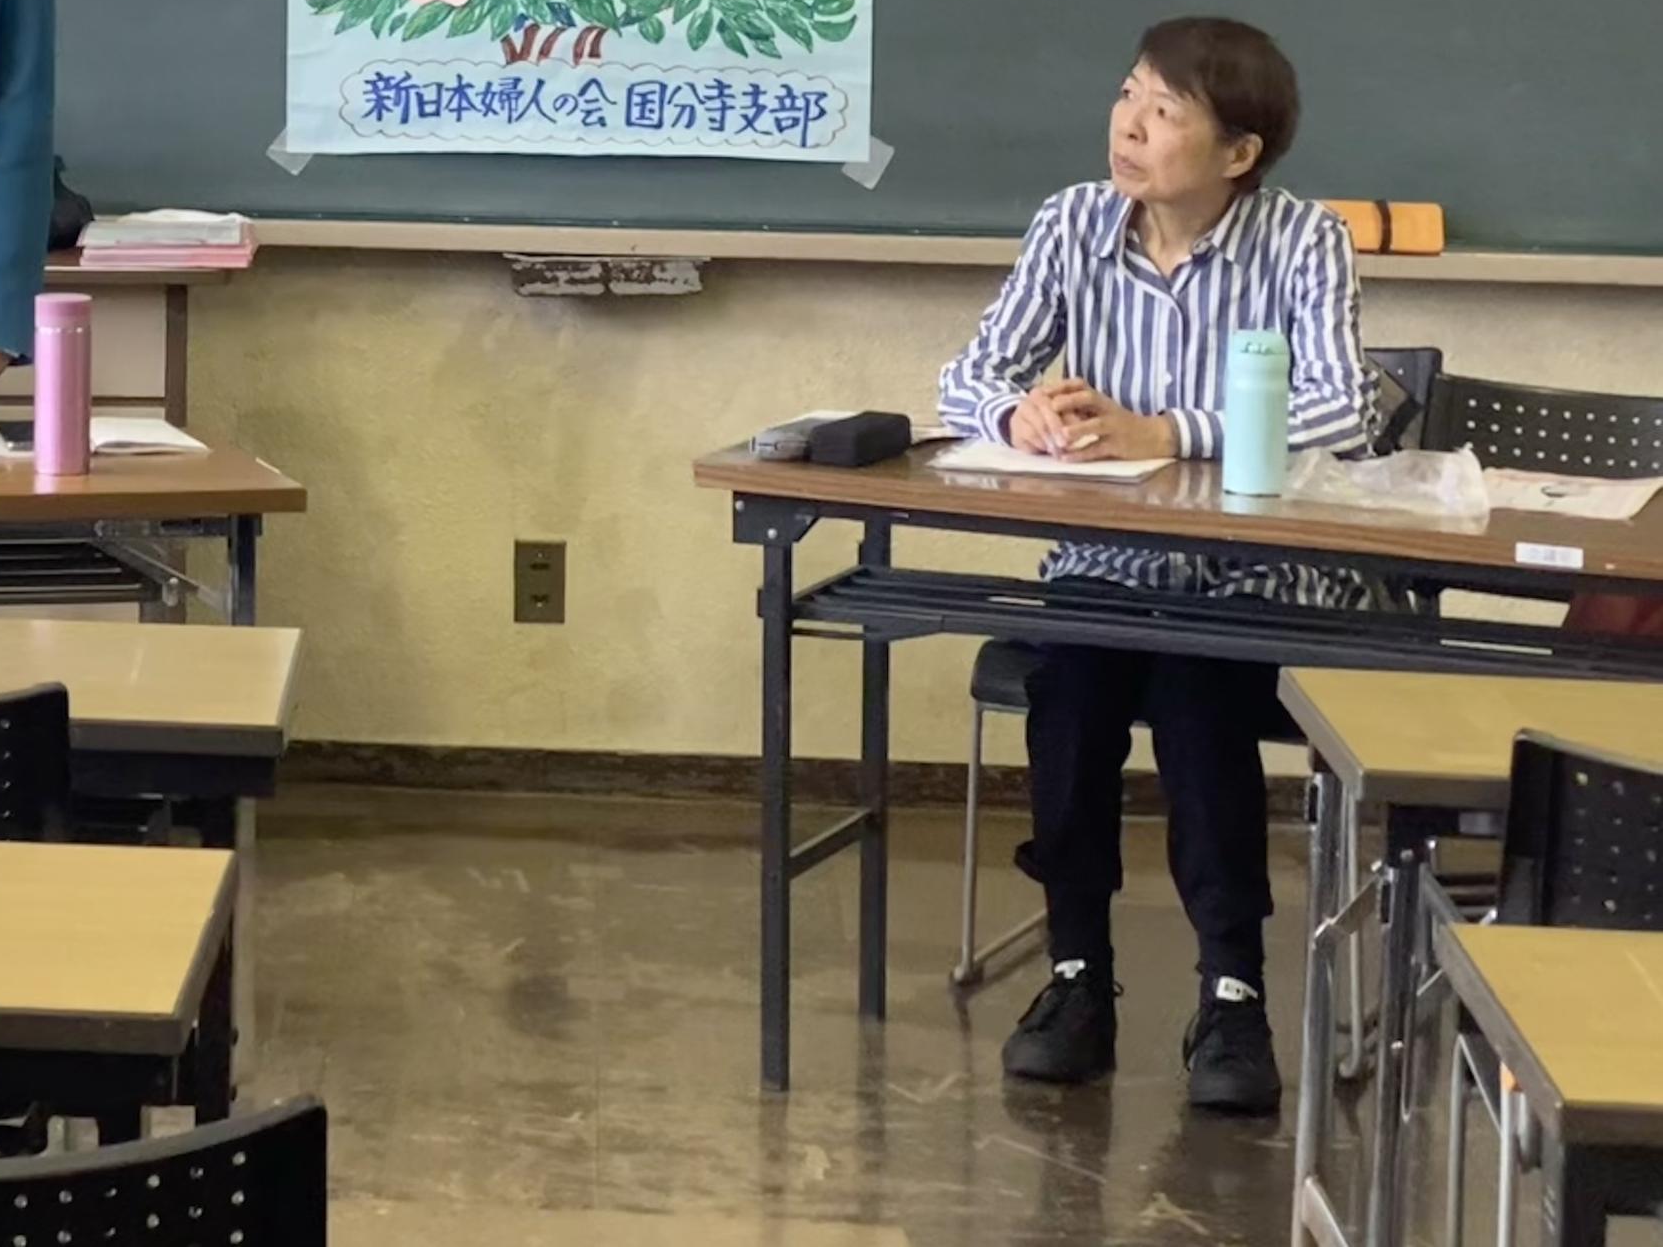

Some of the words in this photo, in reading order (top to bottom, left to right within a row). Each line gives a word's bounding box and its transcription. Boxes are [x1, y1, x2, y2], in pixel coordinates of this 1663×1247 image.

[363, 71, 617, 128] 新日本婦人の会
[626, 78, 828, 148] 国分寺支部
